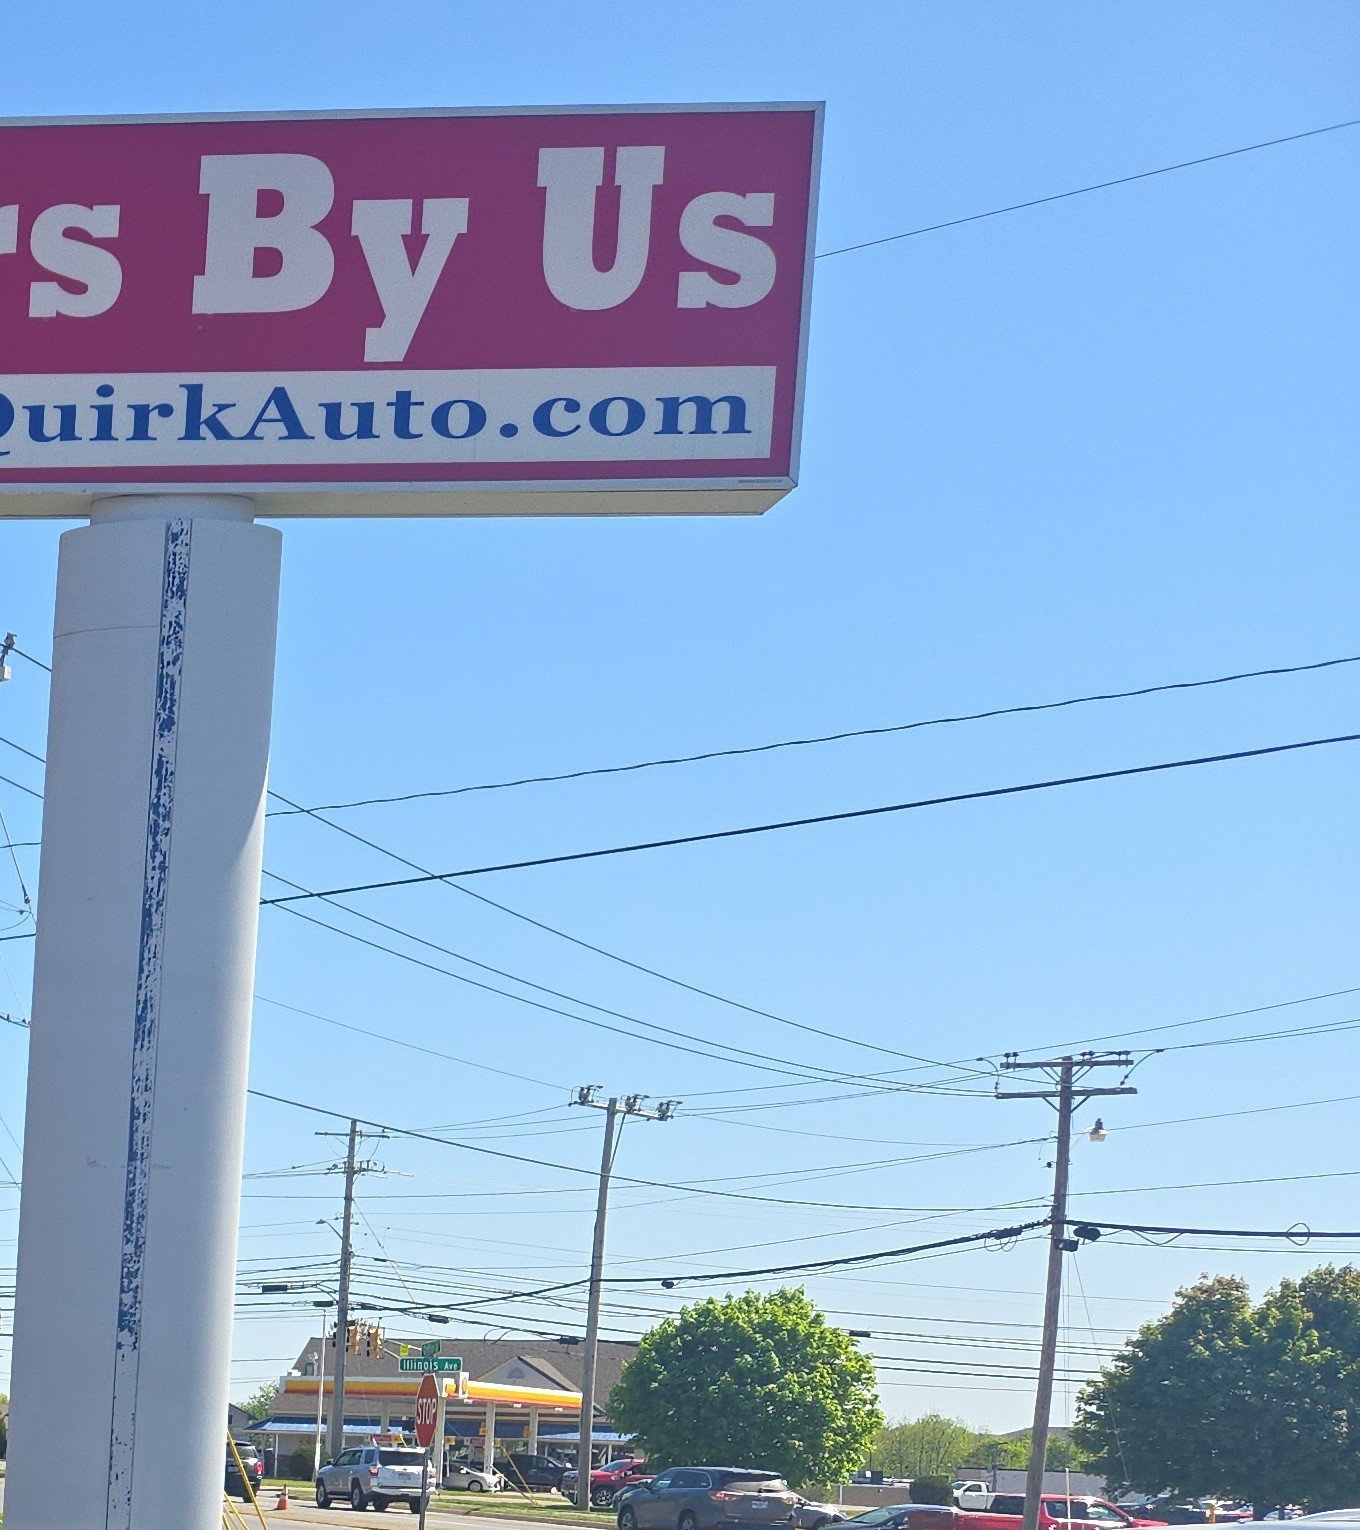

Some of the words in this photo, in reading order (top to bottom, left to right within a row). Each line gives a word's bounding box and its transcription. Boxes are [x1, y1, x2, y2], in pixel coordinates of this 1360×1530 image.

[191, 152, 470, 362] By
[536, 145, 777, 310] Us
[403, 1359, 439, 1371] Illinois
[444, 1361, 458, 1371] Ave
[417, 1398, 437, 1424] STOP
